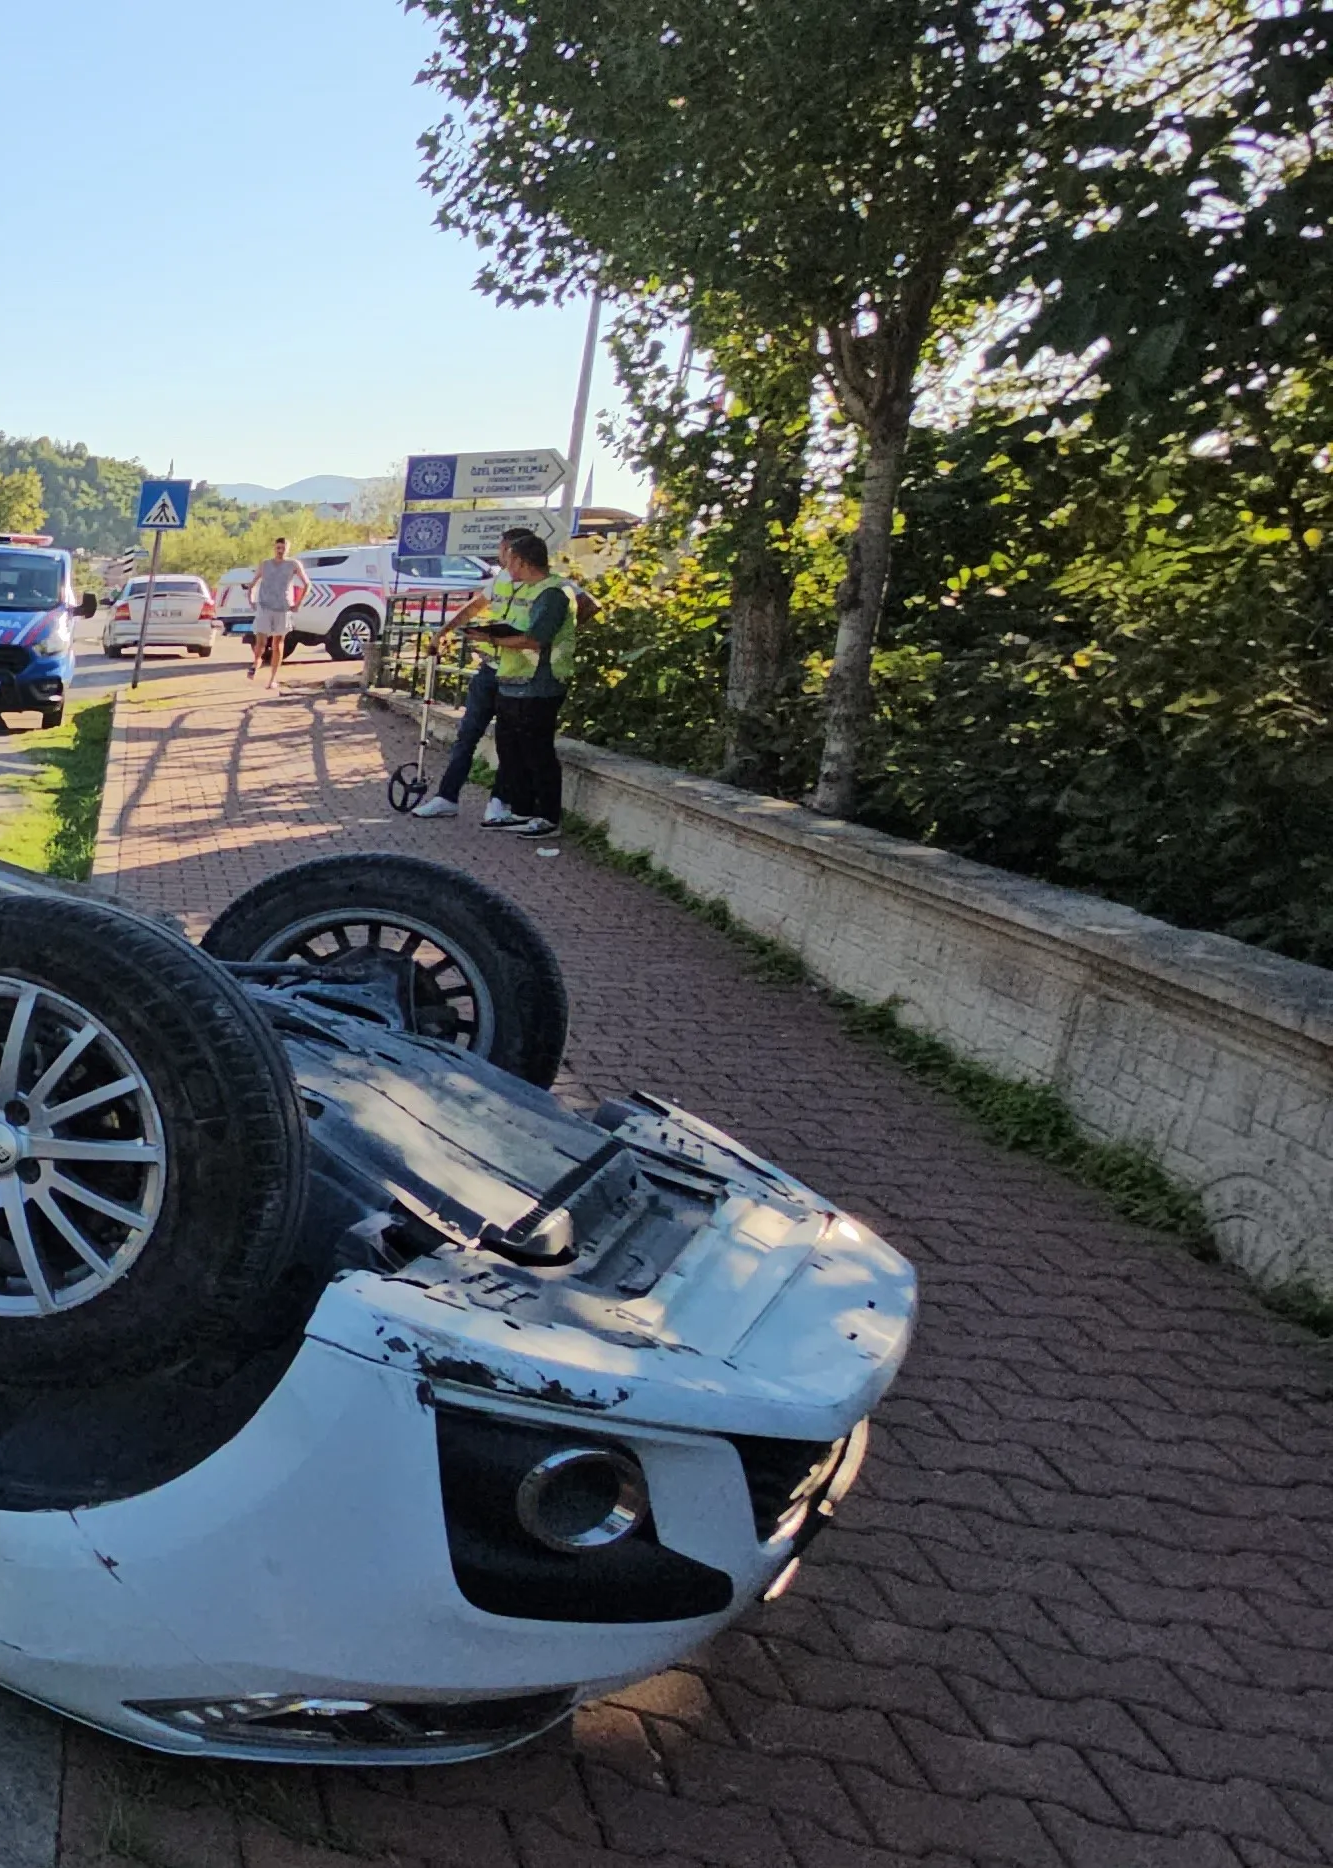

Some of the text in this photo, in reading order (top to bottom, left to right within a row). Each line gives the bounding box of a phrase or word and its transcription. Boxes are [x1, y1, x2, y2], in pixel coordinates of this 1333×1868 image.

[470, 463, 550, 476] ÖZEL EMRE YILMAZ
